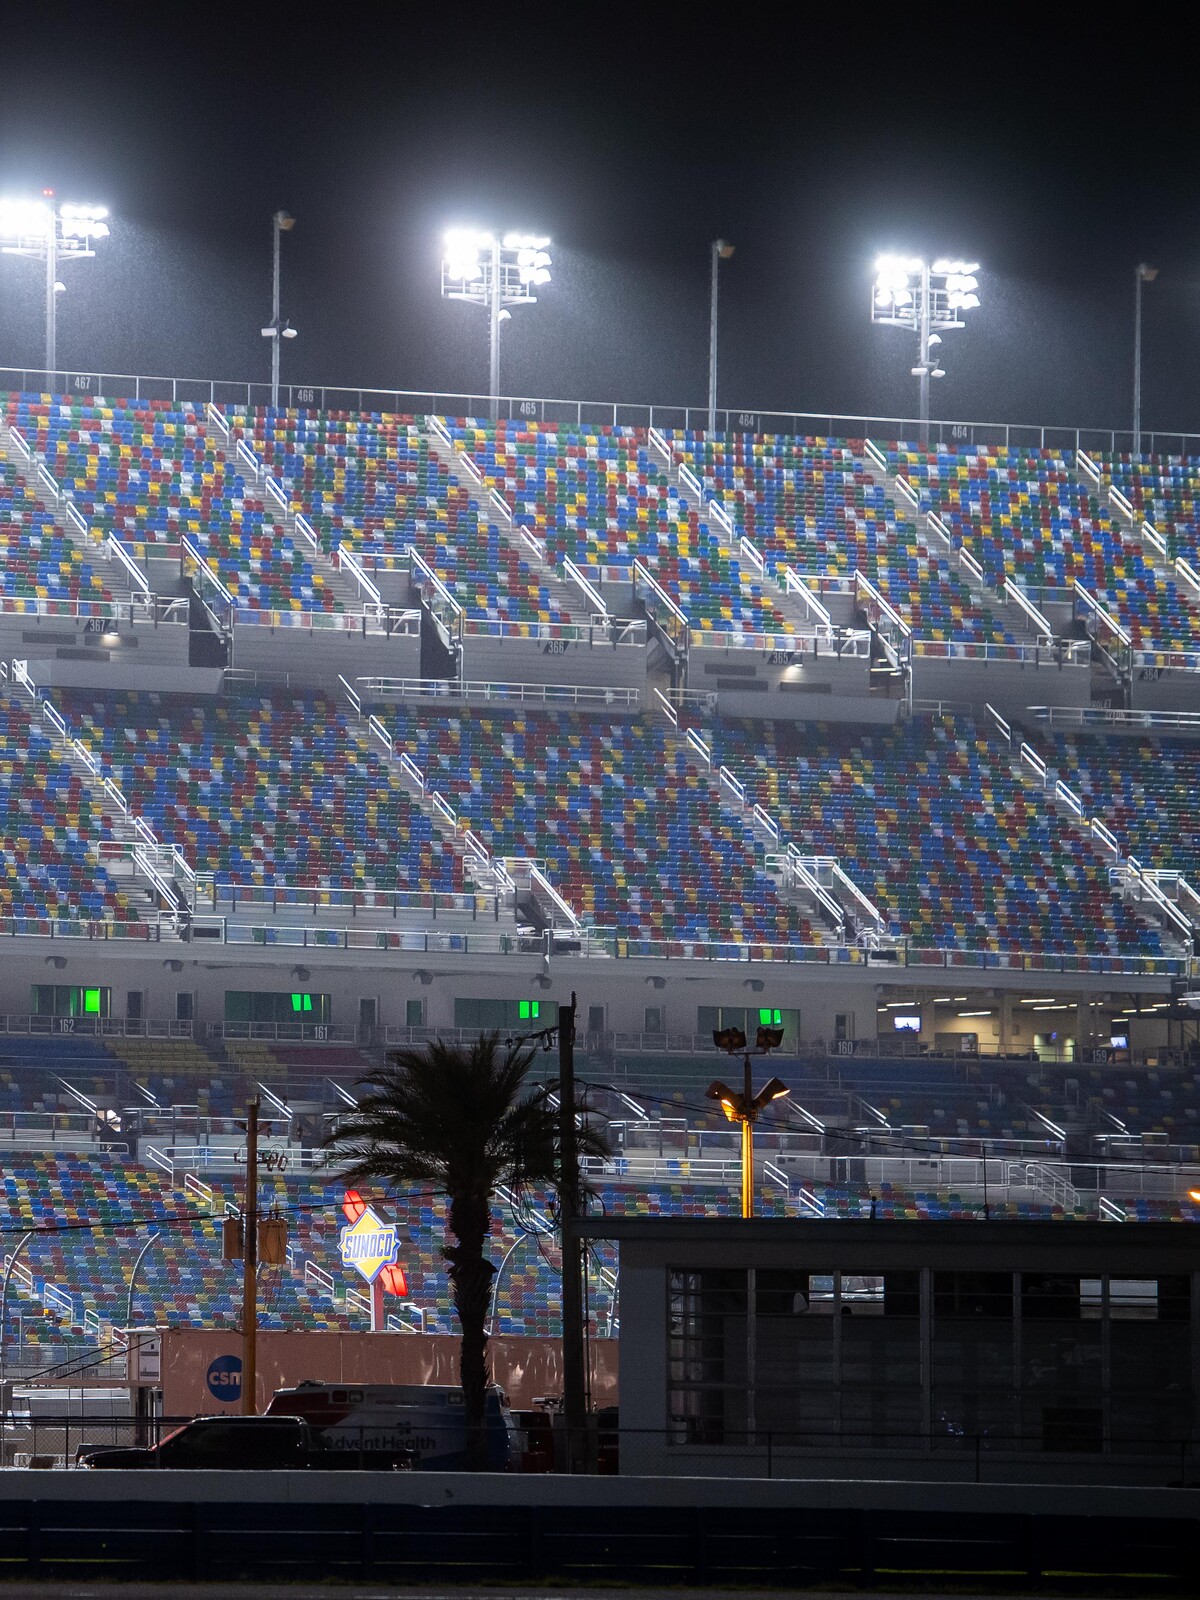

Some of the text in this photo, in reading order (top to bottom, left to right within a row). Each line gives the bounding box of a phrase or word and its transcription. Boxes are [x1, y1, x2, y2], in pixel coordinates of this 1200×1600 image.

[74, 376, 91, 389] 467
[297, 390, 314, 402] 466
[520, 402, 536, 415] 465
[739, 414, 754, 426] 464
[952, 426, 967, 438] 464
[89, 619, 105, 632] 367
[548, 641, 564, 653] 366
[772, 651, 788, 664] 365
[59, 1019, 74, 1033] 162
[314, 1026, 328, 1040] 161
[1092, 1049, 1107, 1063] 159
[344, 1233, 393, 1258] SUNOCO
